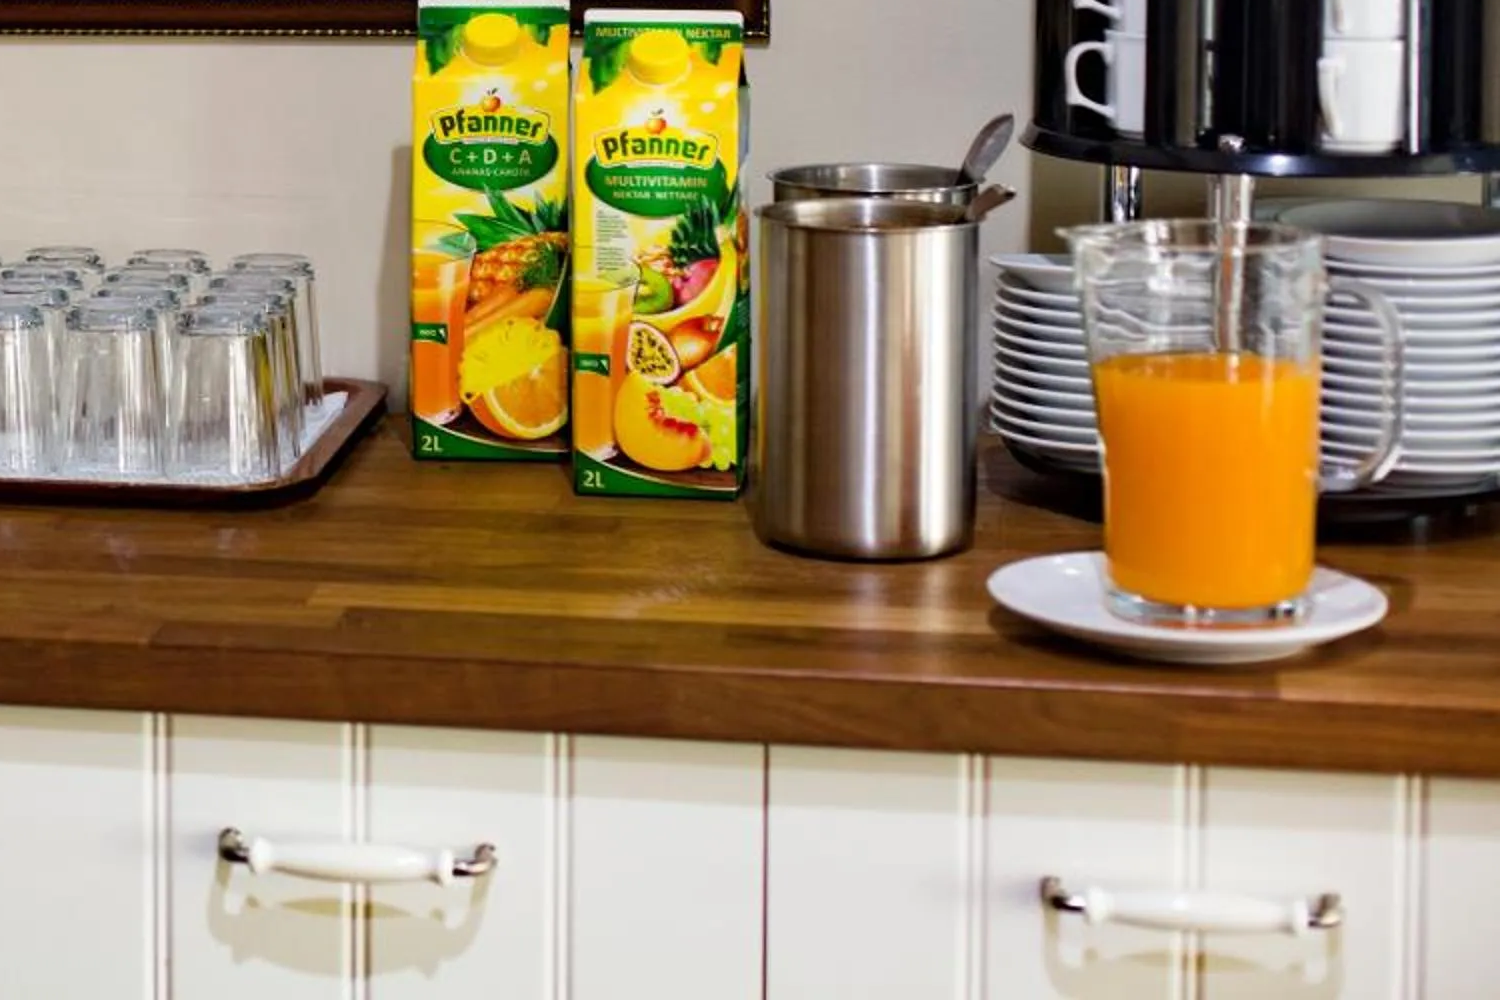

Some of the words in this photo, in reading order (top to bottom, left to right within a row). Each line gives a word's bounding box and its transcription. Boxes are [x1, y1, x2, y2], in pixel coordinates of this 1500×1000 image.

[685, 27, 732, 39] NEKTAR
[603, 175, 708, 189] MULTIVITAMIN
[420, 434, 444, 453] 2L
[582, 469, 606, 489] 2L
